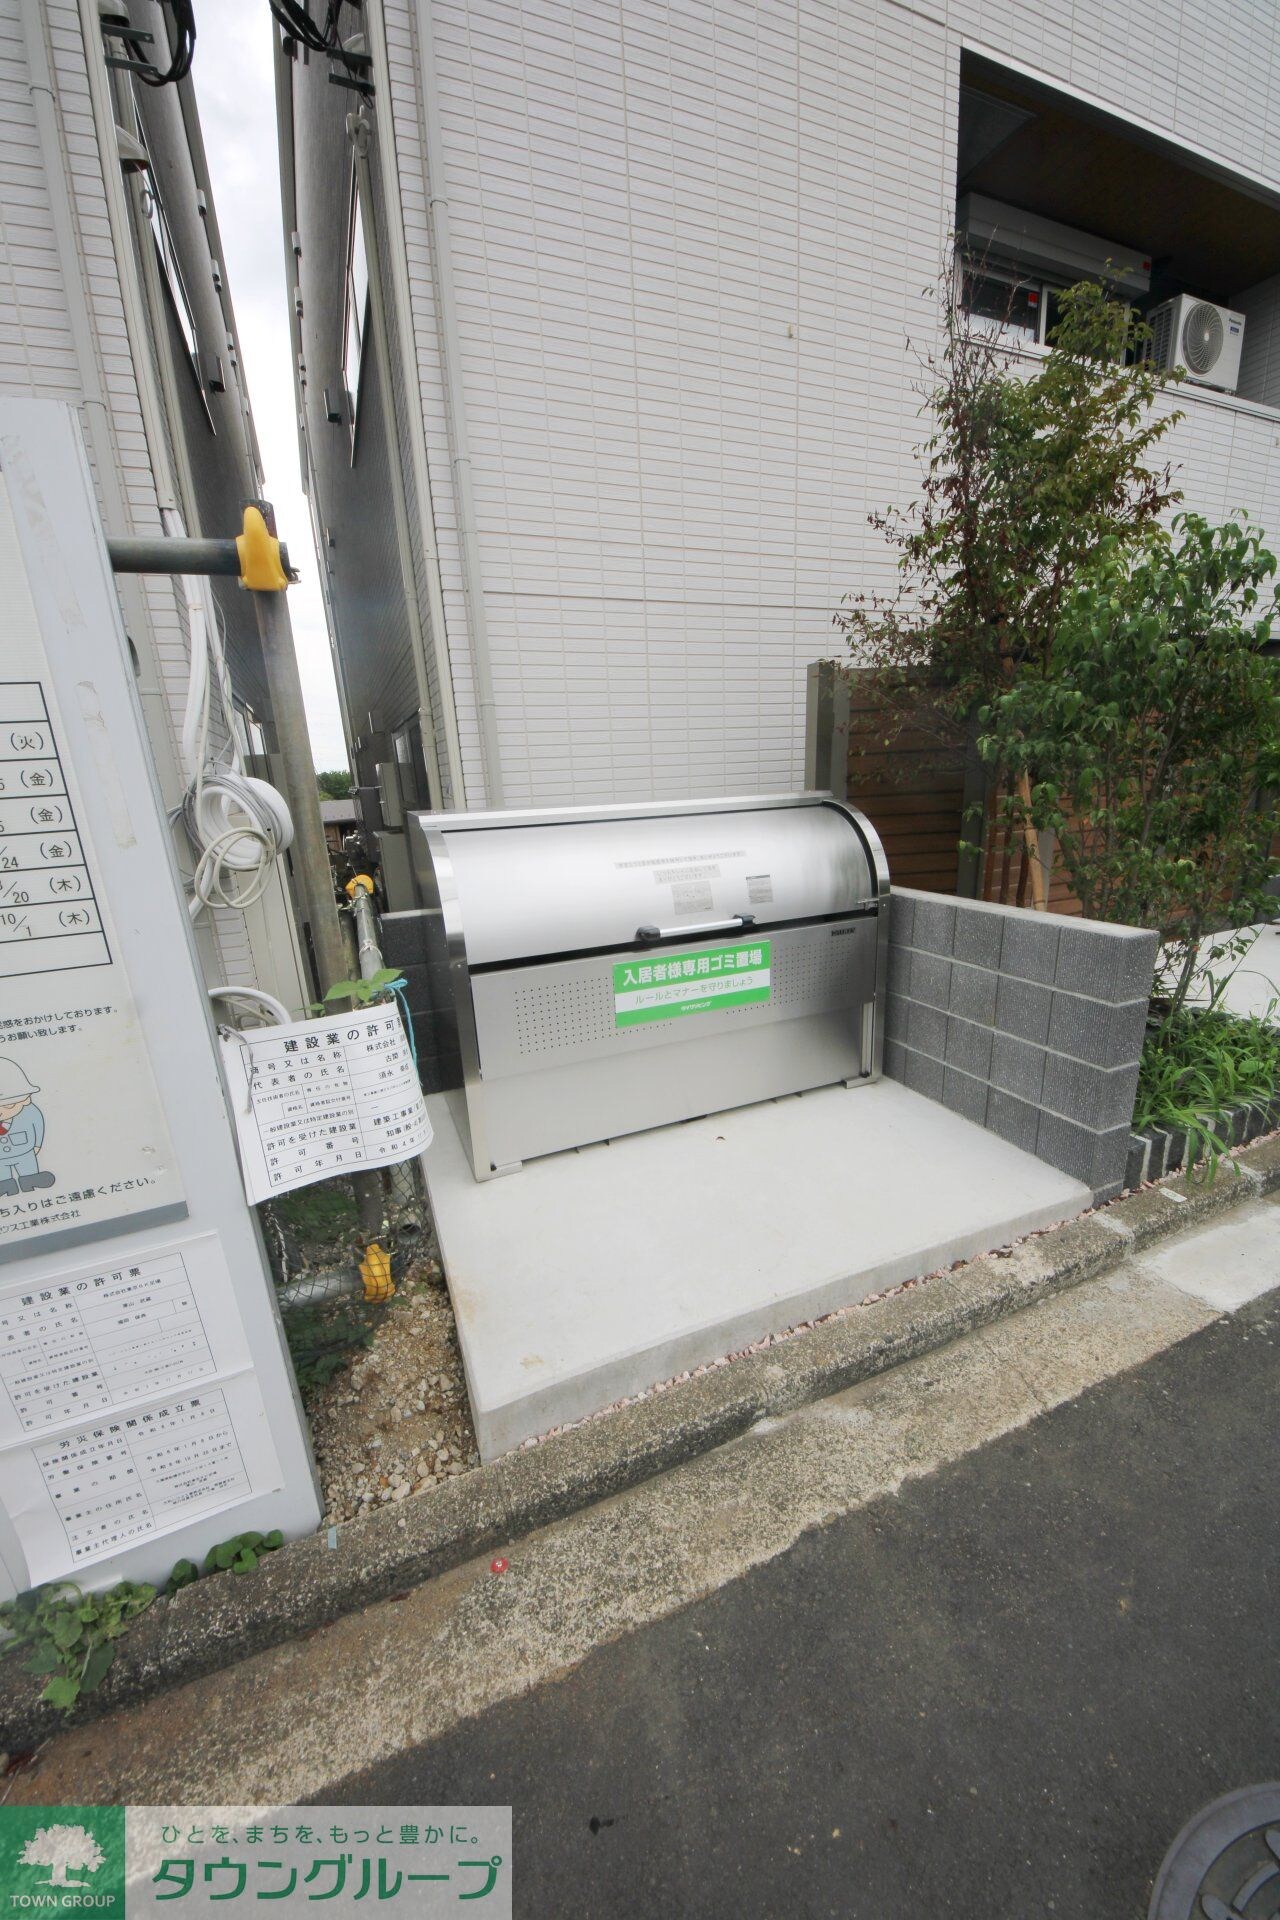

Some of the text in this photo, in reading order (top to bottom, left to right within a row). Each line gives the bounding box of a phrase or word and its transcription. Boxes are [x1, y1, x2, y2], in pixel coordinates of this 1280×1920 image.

[11, 732, 43, 751] (火)
[21, 769, 53, 788] (金)
[31, 805, 62, 824] (金)
[40, 841, 72, 859] (金)
[50, 875, 81, 894] (木)
[59, 909, 90, 927] (木)
[623, 949, 762, 986] 入居者様専用ゴミ置場
[635, 976, 753, 1006] ルールとマナーを守りましょう
[21, 1267, 141, 1306] 建設業の許可票
